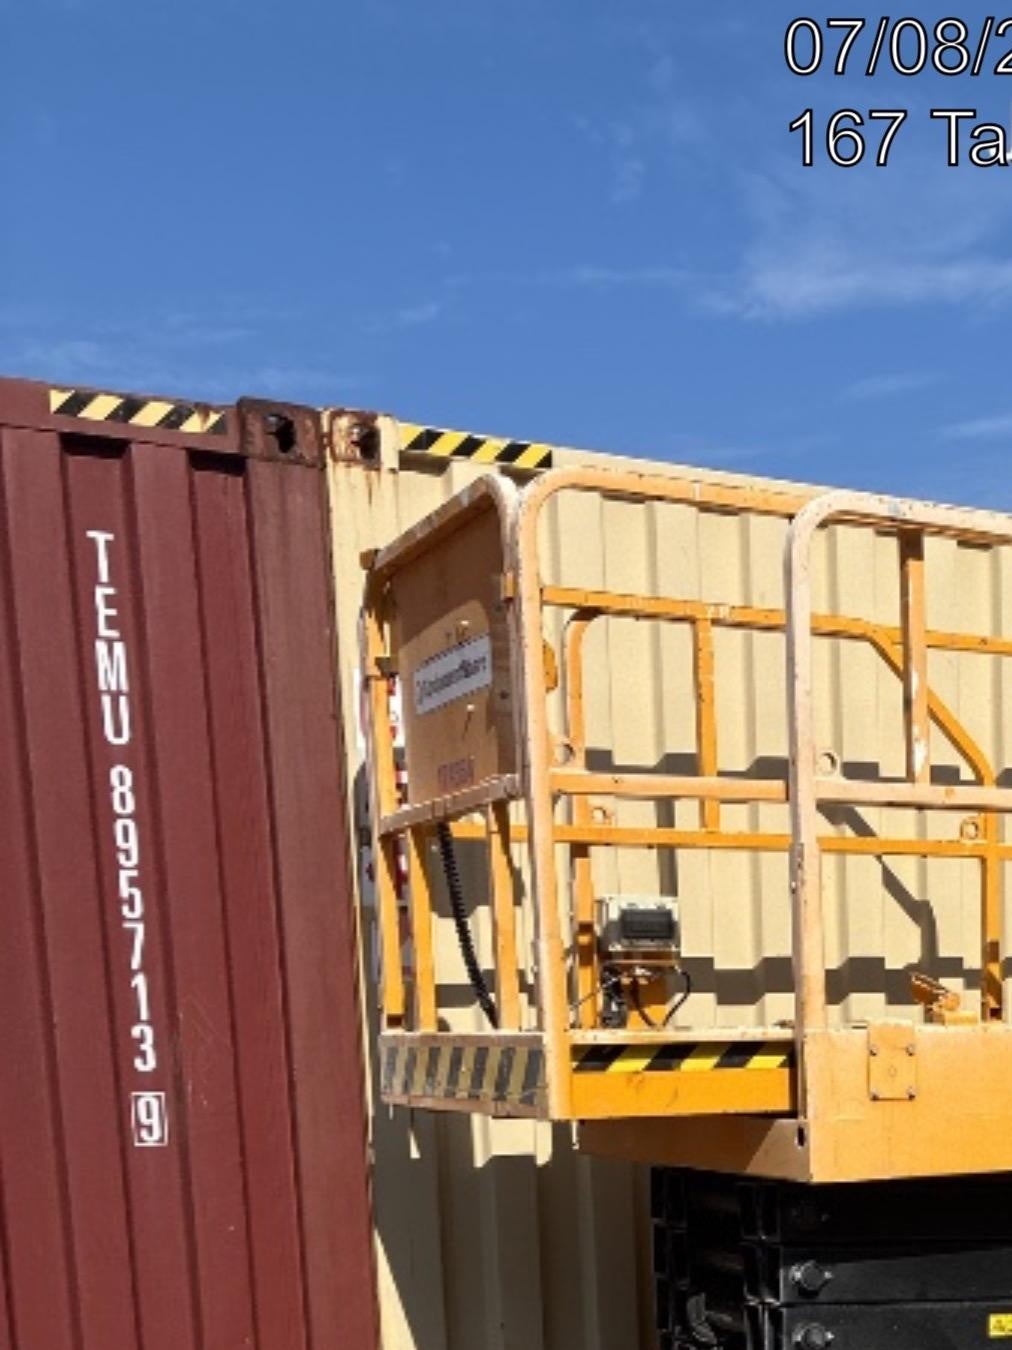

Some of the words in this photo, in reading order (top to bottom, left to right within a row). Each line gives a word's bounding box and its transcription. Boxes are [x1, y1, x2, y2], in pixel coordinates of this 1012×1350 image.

[86, 530, 131, 745] TEMU
[109, 765, 157, 1073] 895713
[133, 1094, 165, 1145] 9
